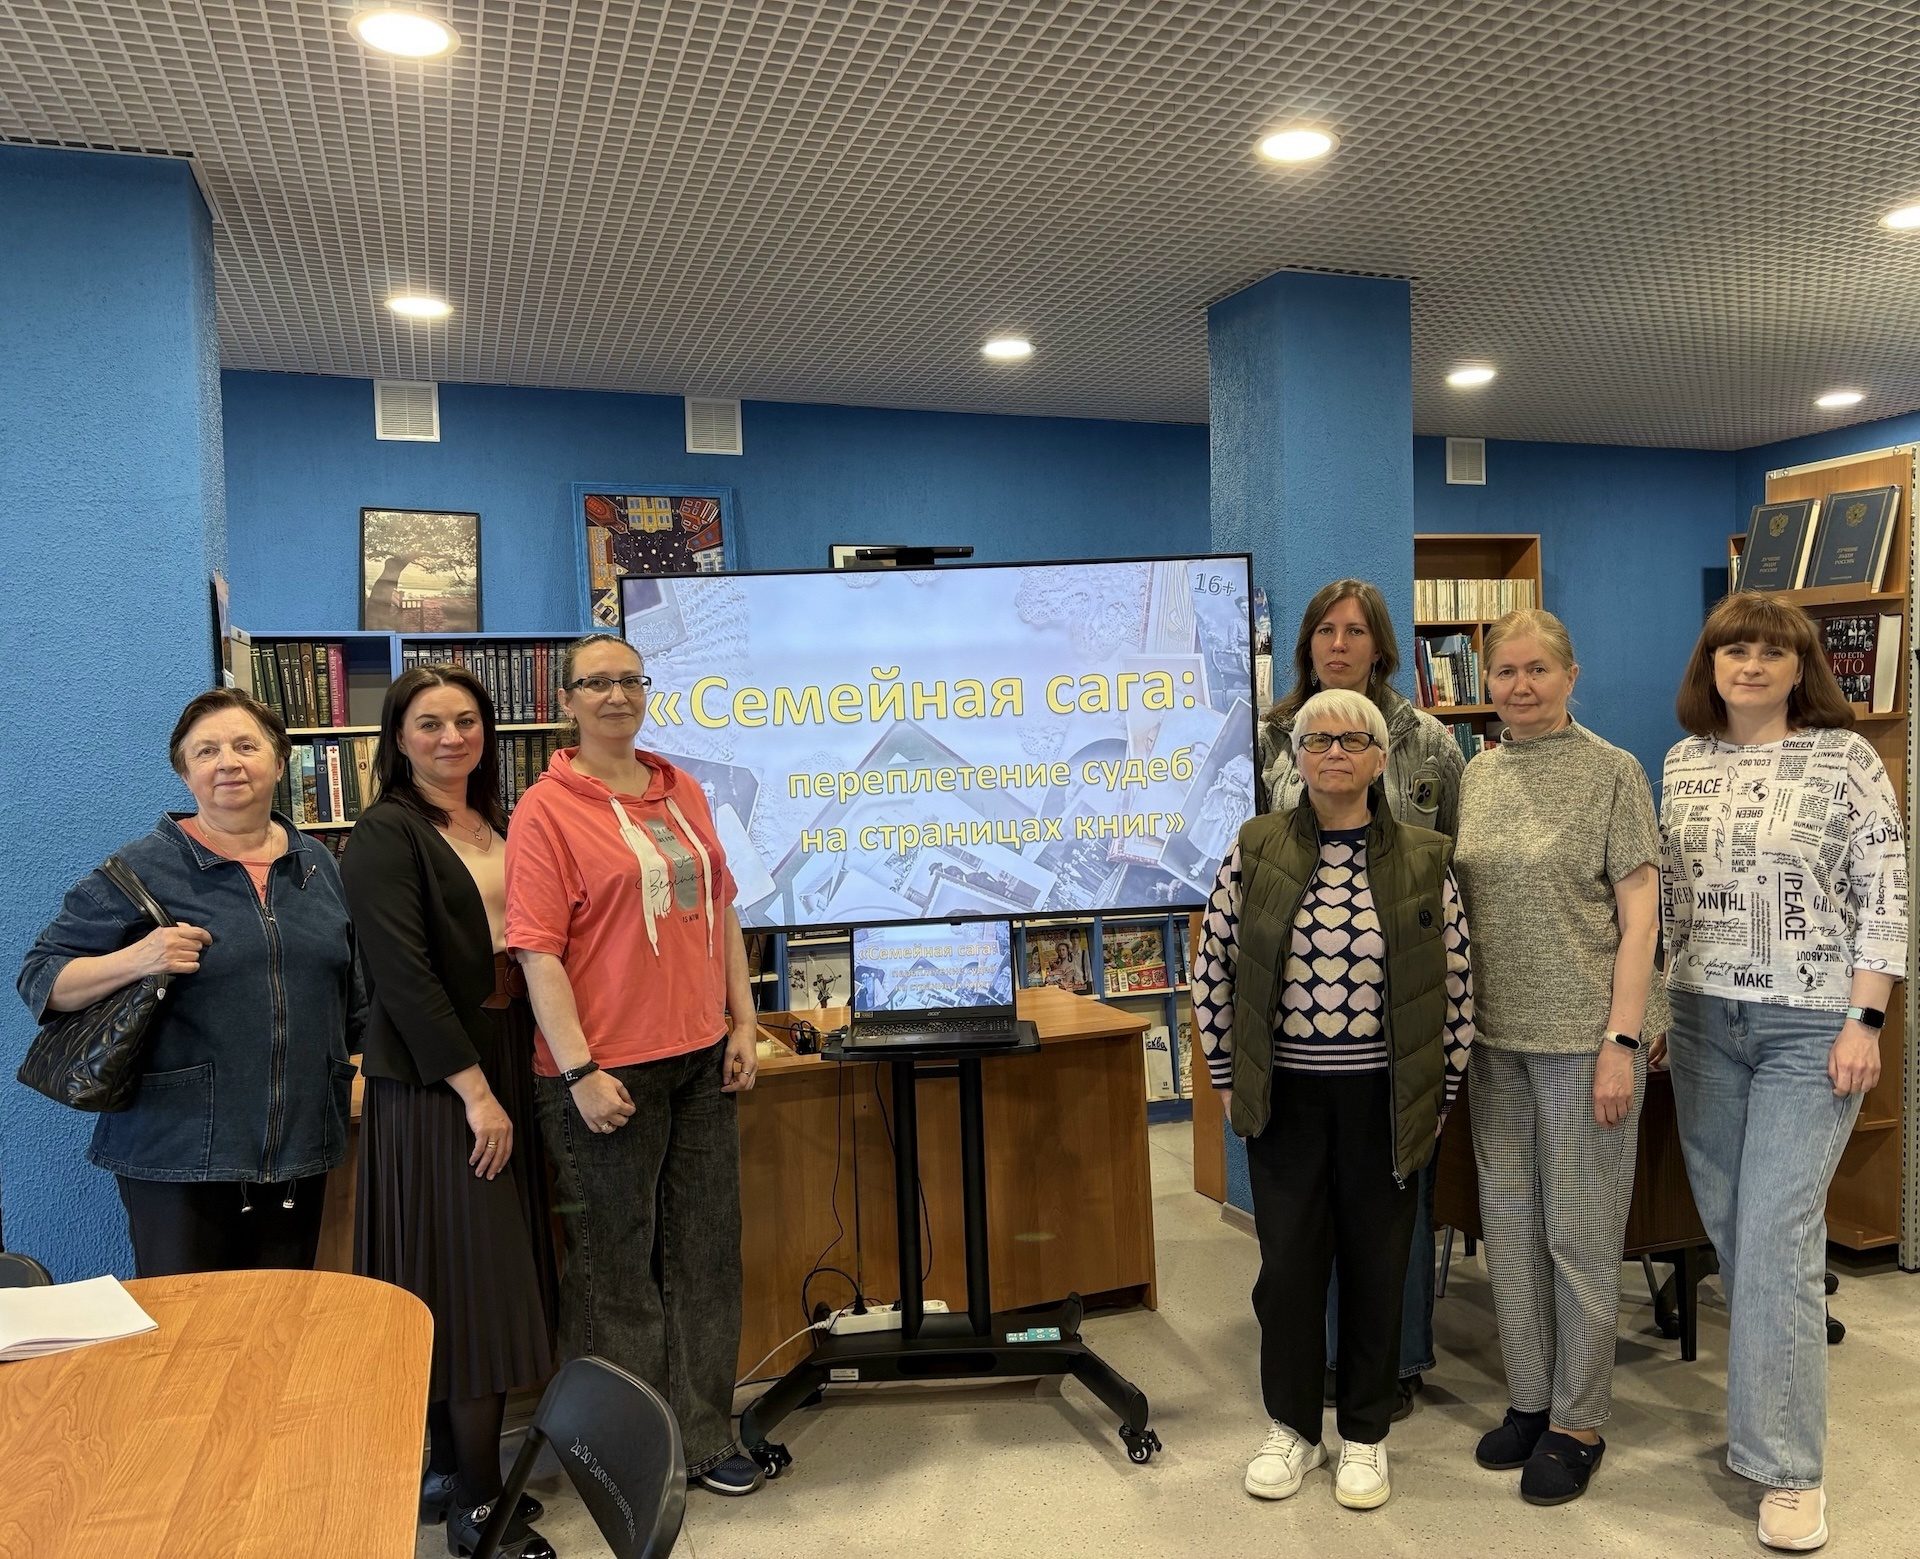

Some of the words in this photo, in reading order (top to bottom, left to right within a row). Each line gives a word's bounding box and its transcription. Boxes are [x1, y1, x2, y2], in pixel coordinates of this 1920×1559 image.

[1193, 571, 1237, 598] 16+
[1833, 652, 1847, 660] КТО
[1847, 651, 1865, 659] ЕСТЬ
[1832, 659, 1865, 675] КТО
[648, 666, 1024, 729] «Семейная
[1046, 669, 1196, 715] сага:
[1782, 740, 1815, 748] GREEN
[1737, 759, 1771, 767] ECOLOGY
[787, 761, 1072, 804] переплетение
[1081, 746, 1194, 792] судеб
[1735, 809, 1764, 819] GREEN
[800, 825, 847, 855] на
[859, 819, 1063, 857] страницах
[1074, 808, 1186, 840] книг»
[1697, 891, 1747, 915] THINK
[1796, 951, 1823, 962] ABOUT
[1733, 972, 1774, 988] MAKE
[1146, 1036, 1168, 1051] сква
